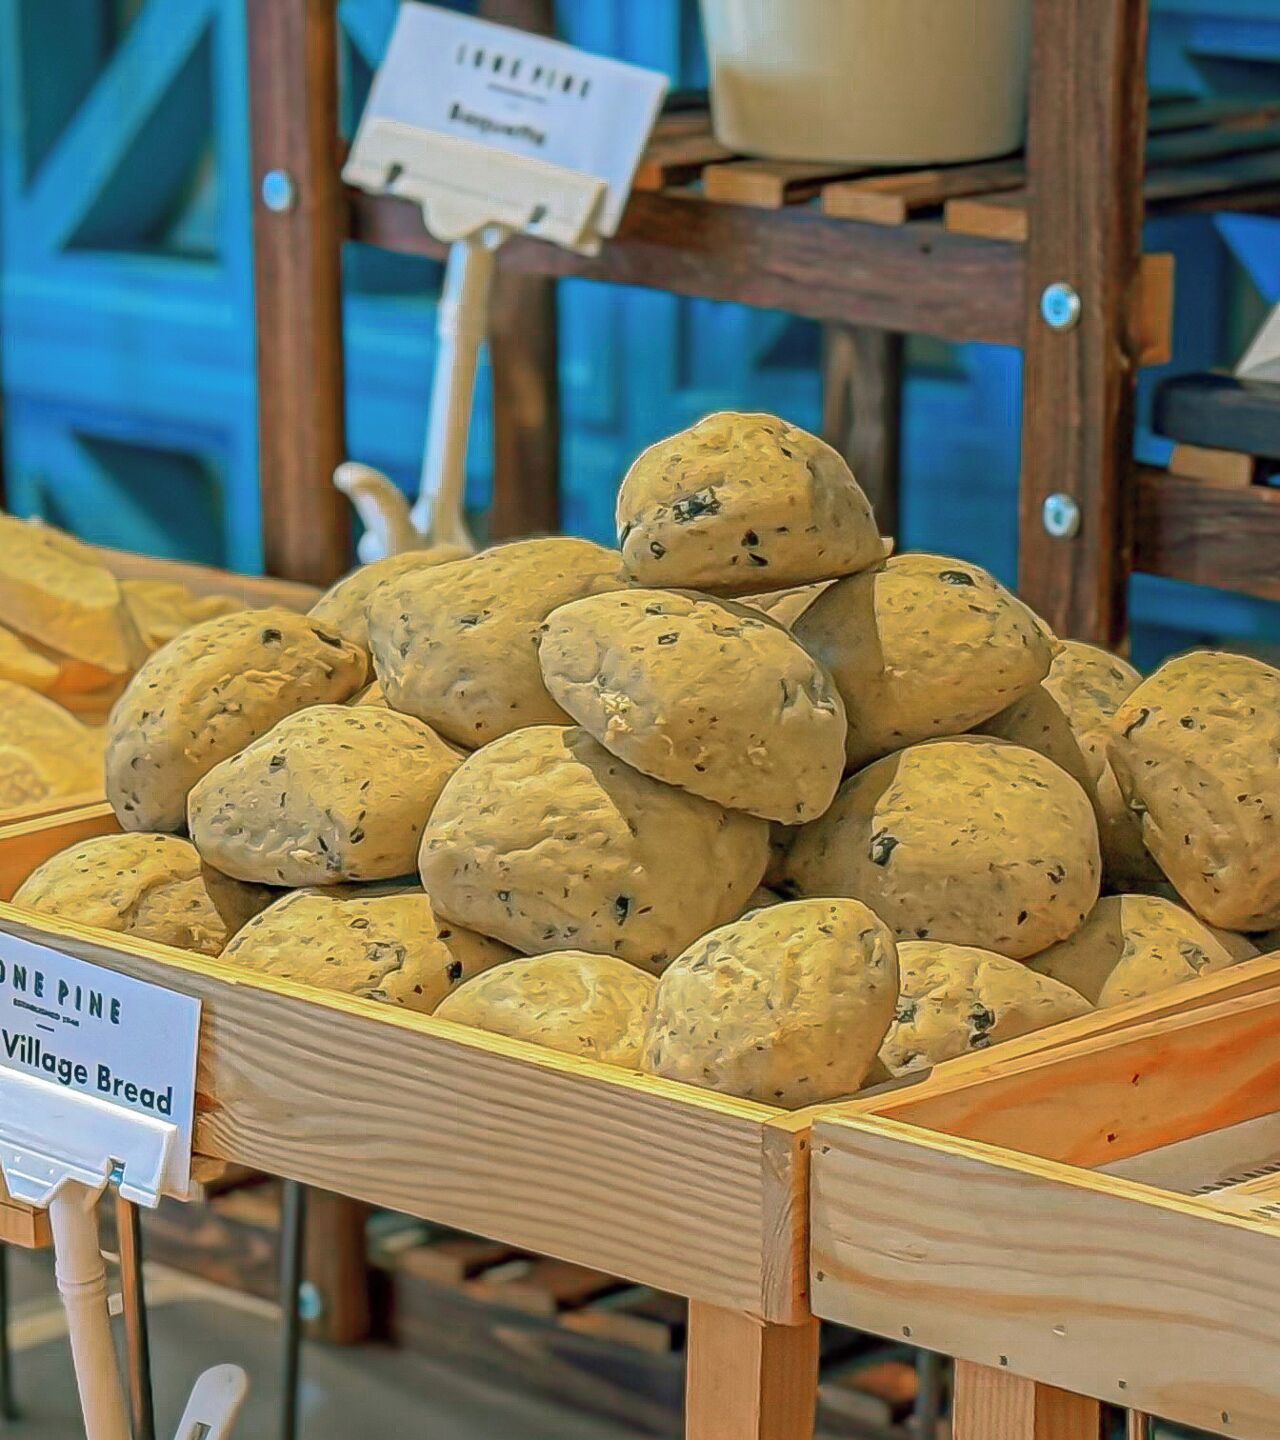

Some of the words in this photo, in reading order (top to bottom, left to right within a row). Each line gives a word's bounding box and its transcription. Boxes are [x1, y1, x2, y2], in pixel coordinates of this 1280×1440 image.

[58, 979, 122, 1025] PINE
[2, 1028, 88, 1086] Village
[97, 1063, 173, 1116] Bread
